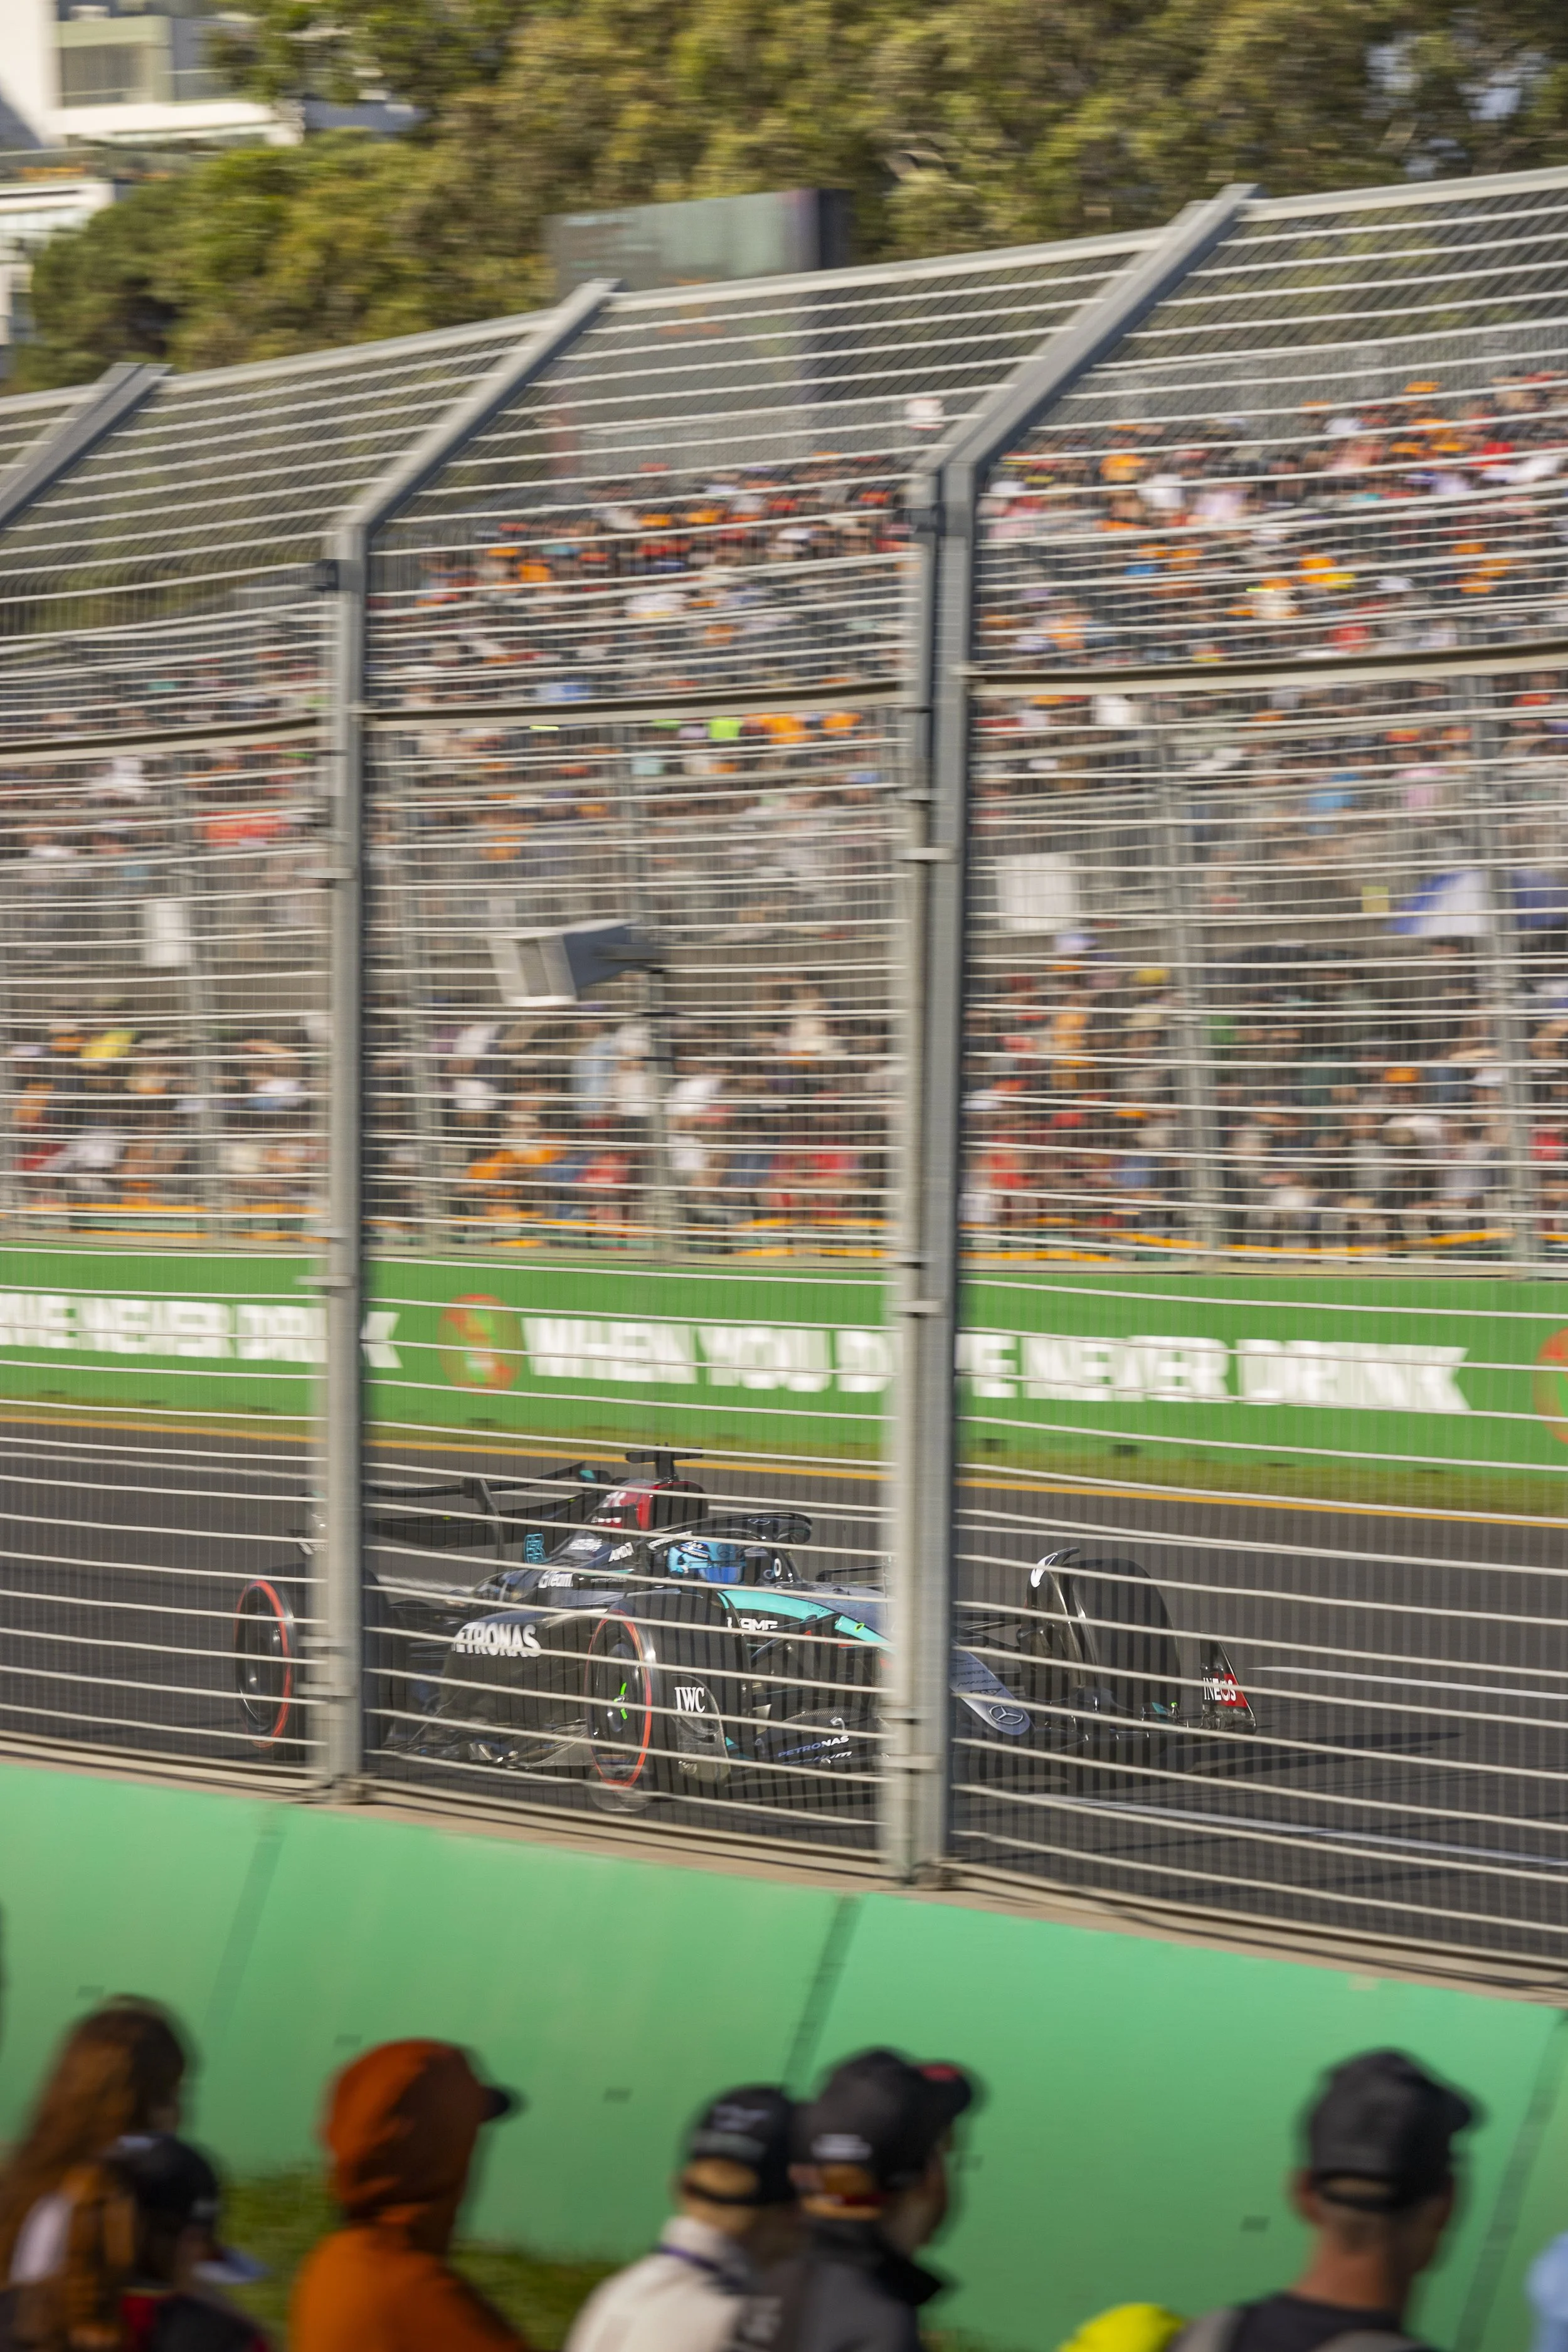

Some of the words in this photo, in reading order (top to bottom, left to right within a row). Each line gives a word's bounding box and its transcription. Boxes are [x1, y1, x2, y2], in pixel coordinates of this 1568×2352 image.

[522, 1318, 697, 1384] WHEN
[698, 1326, 831, 1392] YOU
[1021, 1336, 1229, 1402] NEVER
[1236, 1339, 1470, 1410] DRINK
[674, 1687, 706, 1713] IWC
[1203, 1677, 1236, 1702] INEOS
[778, 1735, 850, 1757] PETRONAS
